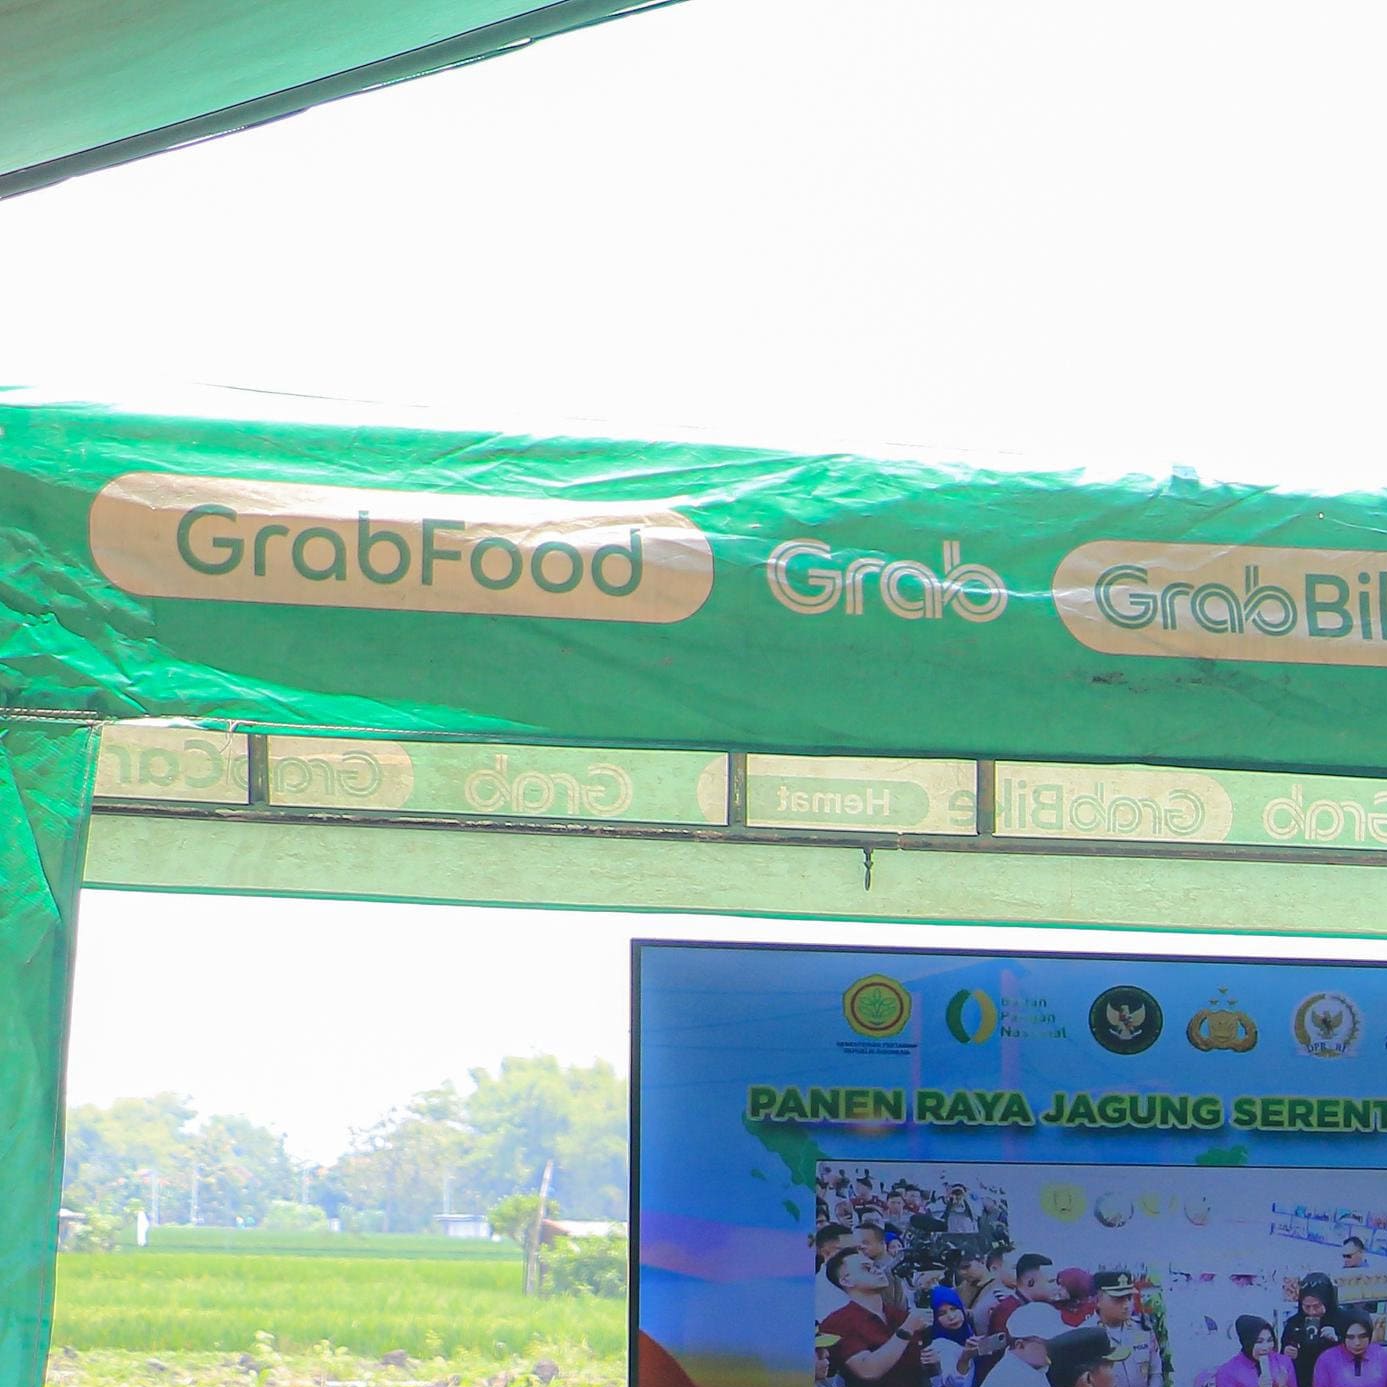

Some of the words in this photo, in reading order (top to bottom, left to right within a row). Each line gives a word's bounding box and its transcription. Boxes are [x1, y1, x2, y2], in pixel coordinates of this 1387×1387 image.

[177, 504, 643, 597] GrabFood
[766, 539, 1008, 622] Grab
[748, 1086, 907, 1122] PANEN
[914, 1090, 1033, 1126] RAYA
[1043, 1093, 1222, 1129] JAGUNG
